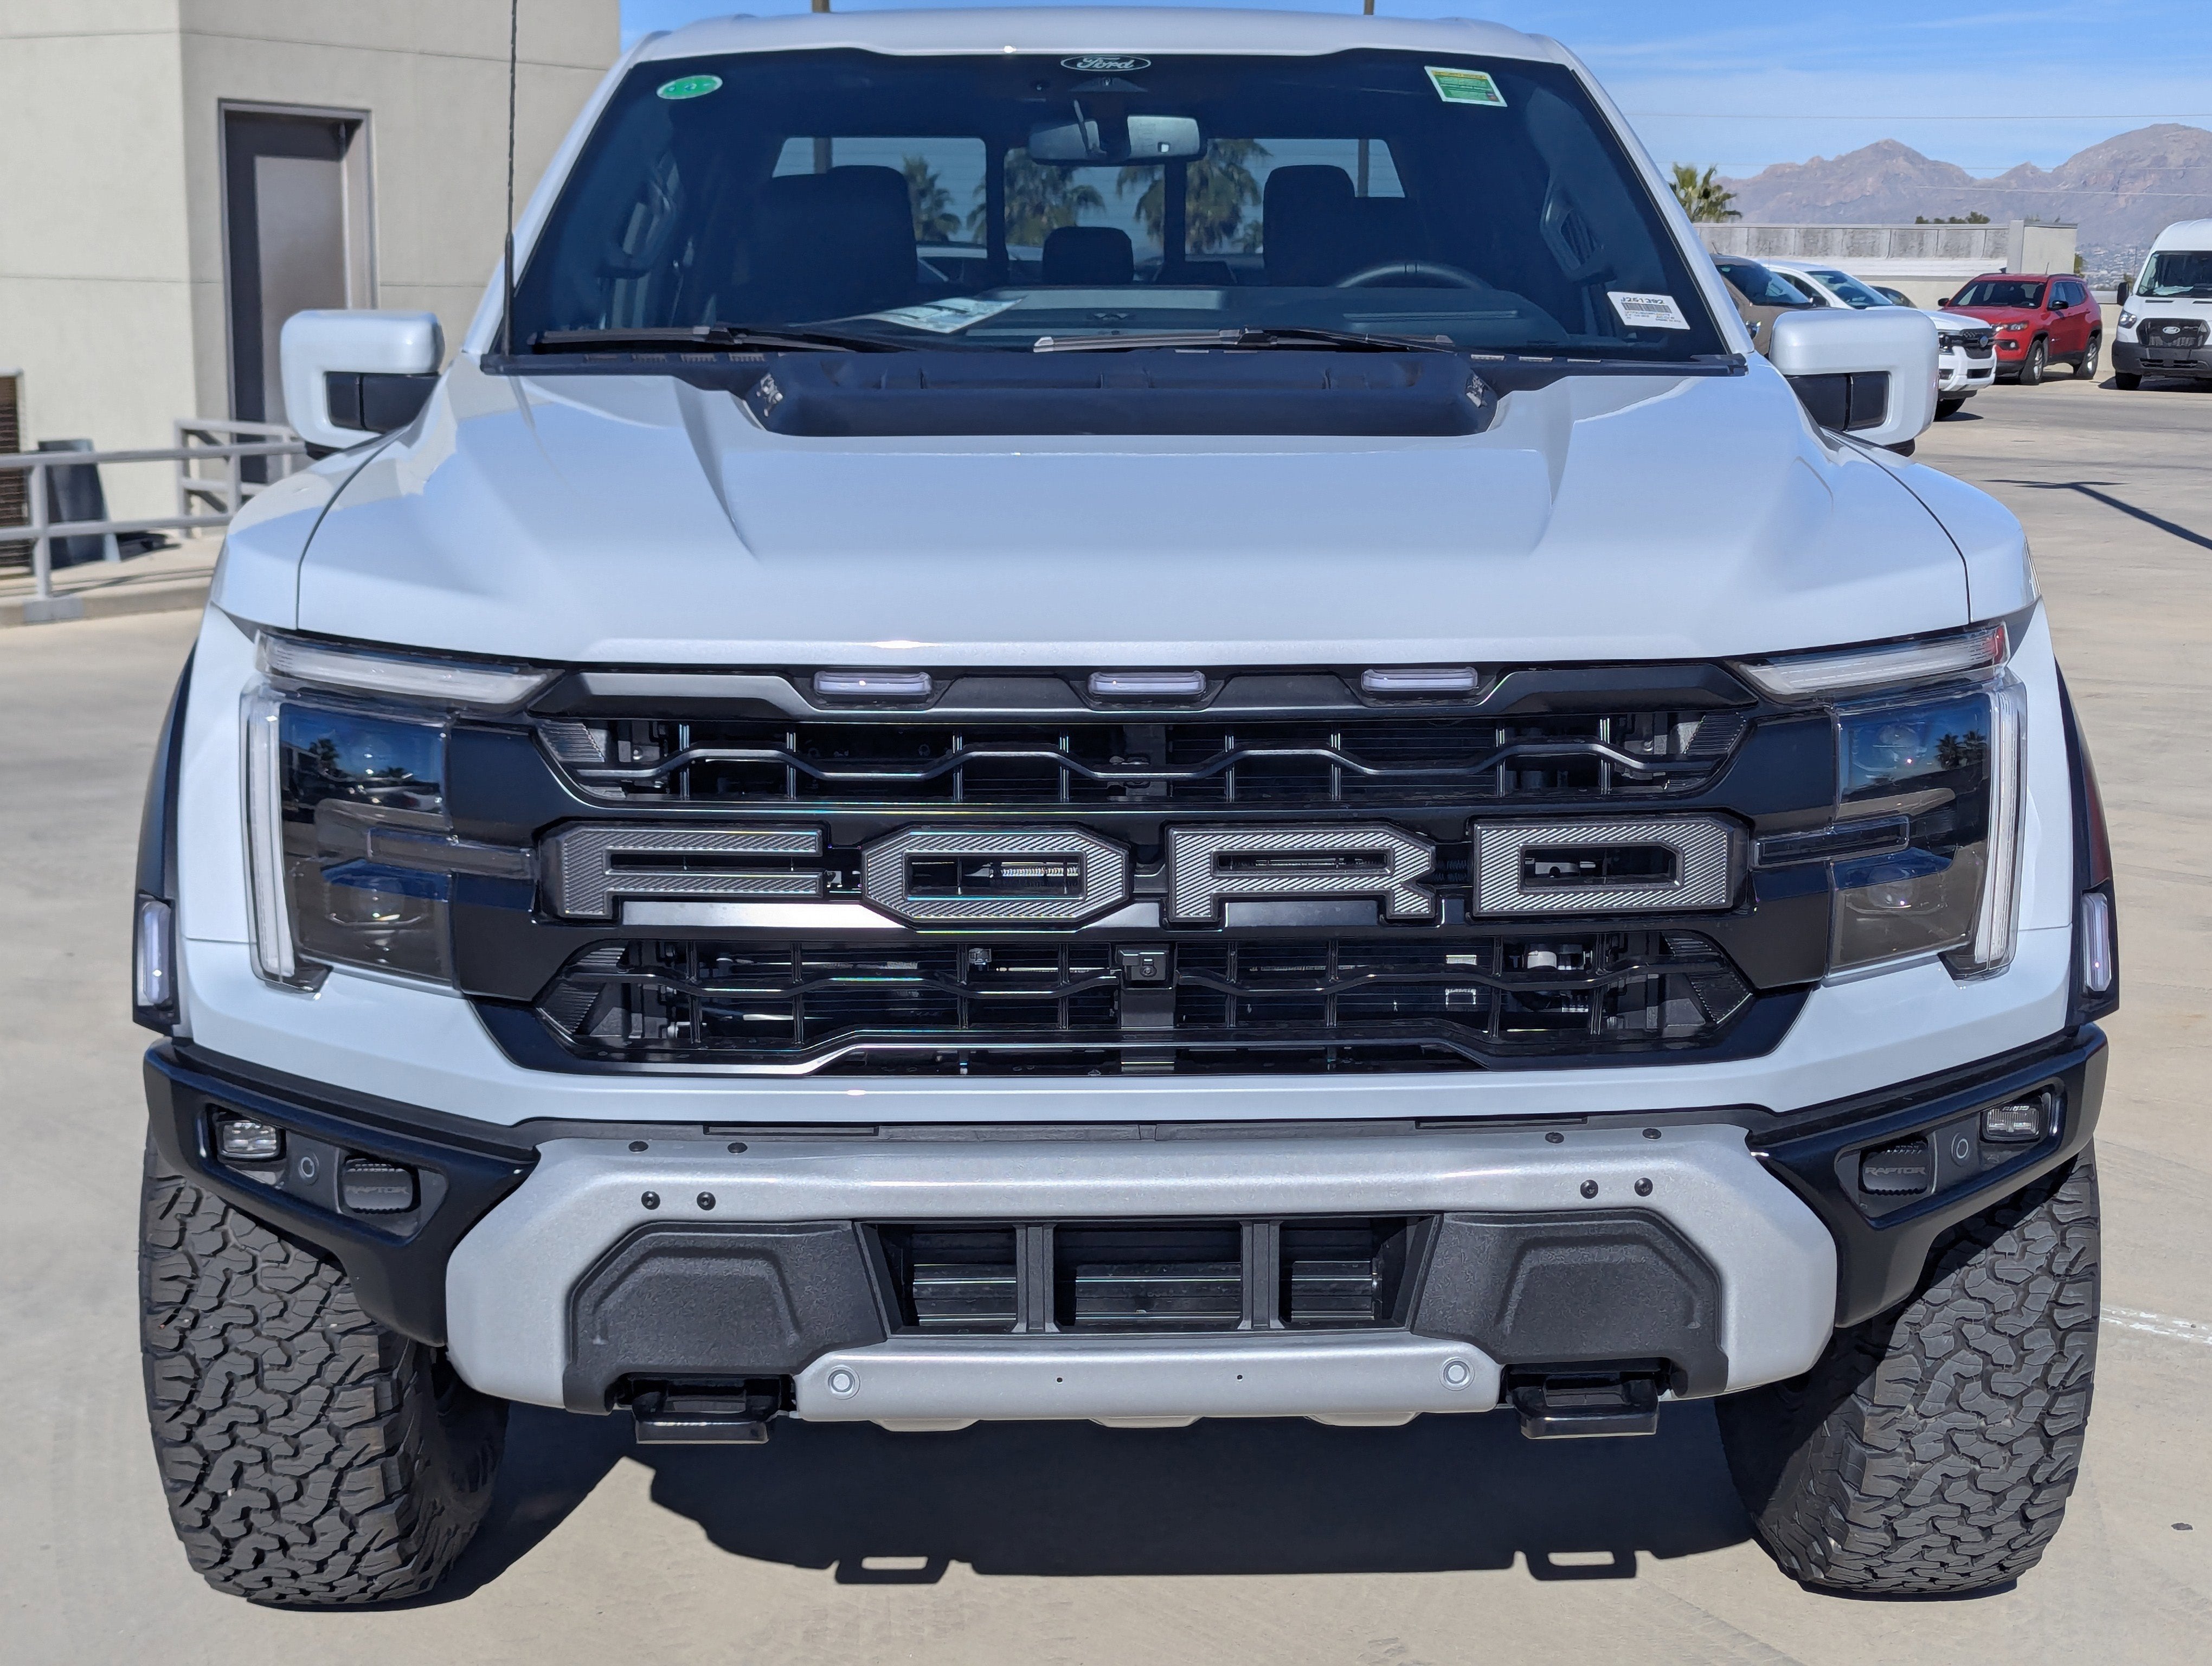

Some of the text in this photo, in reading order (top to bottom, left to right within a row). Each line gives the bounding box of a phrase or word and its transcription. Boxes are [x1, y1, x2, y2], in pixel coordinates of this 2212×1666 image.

[1076, 56, 1135, 70] Ford
[553, 819, 1741, 924] FORD
[1864, 1167, 1927, 1176] RAPTOR
[344, 1185, 410, 1195] RAPTOR
